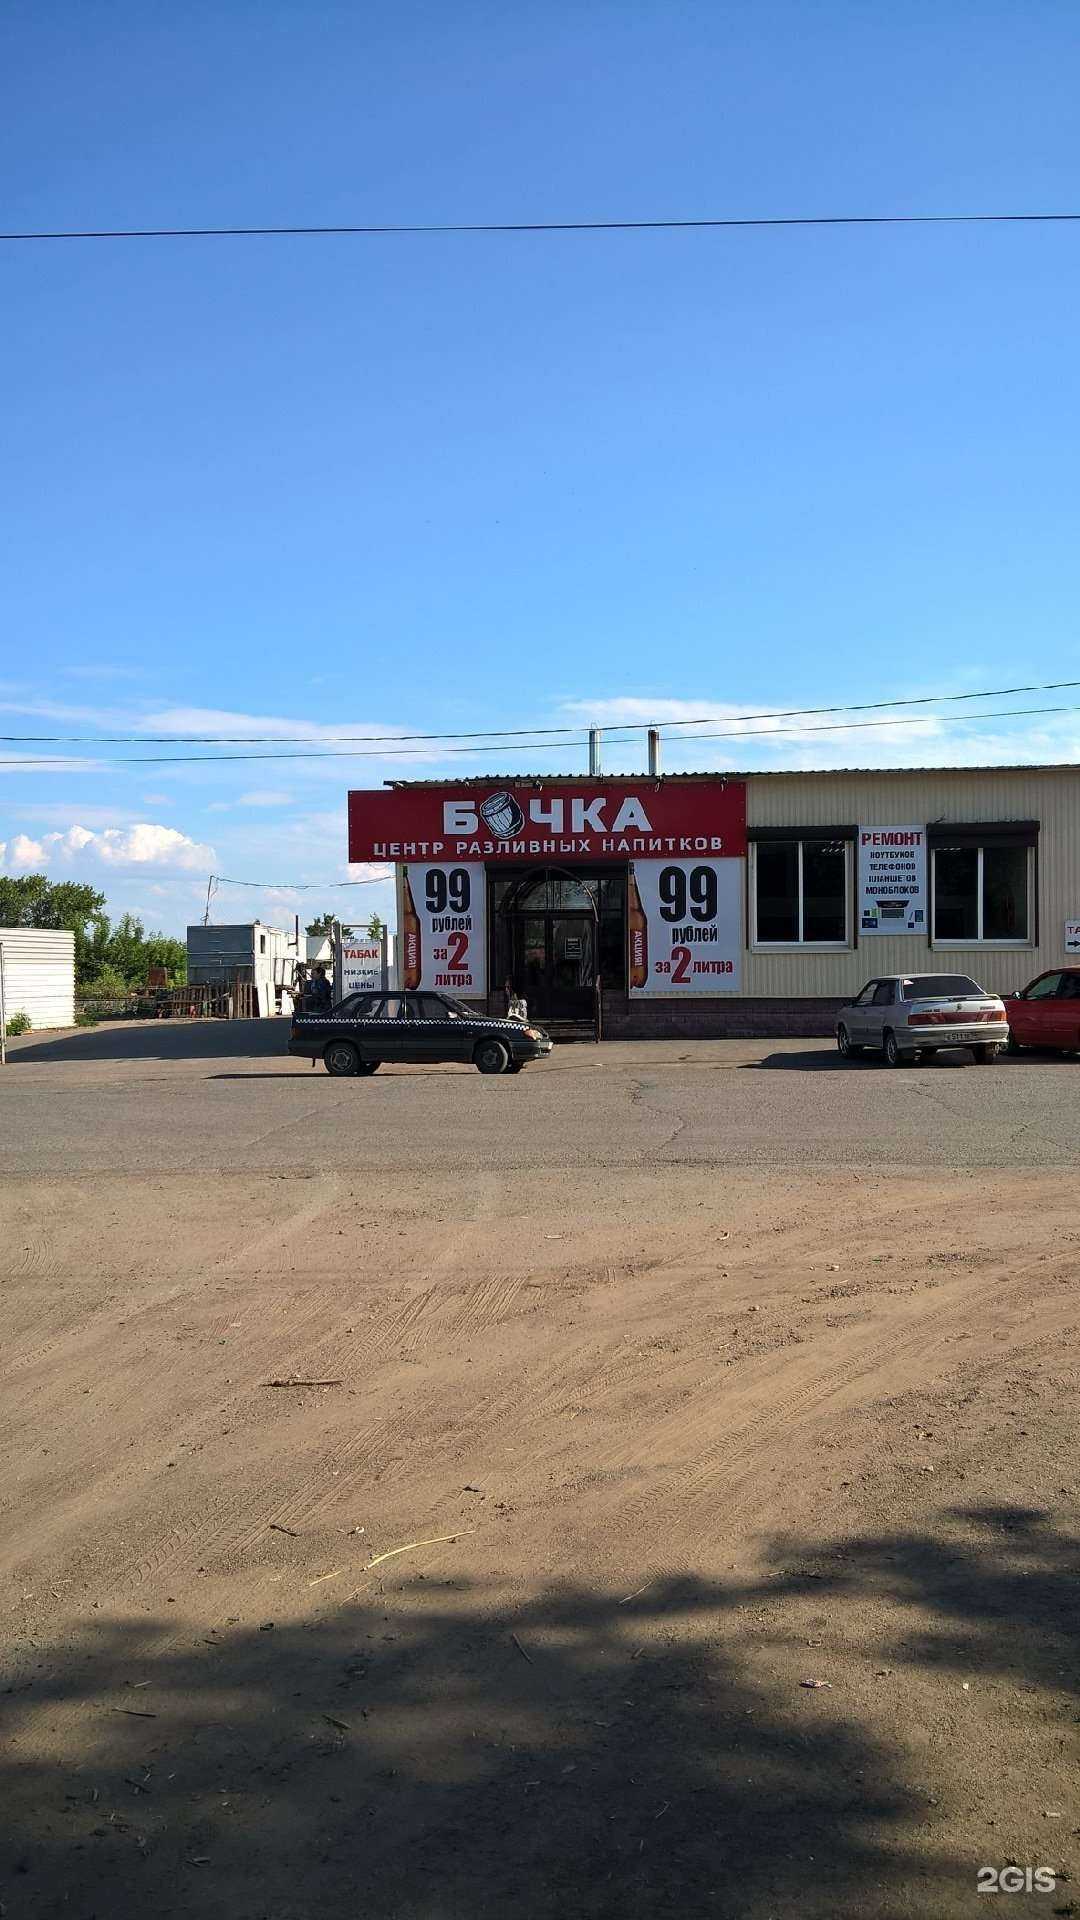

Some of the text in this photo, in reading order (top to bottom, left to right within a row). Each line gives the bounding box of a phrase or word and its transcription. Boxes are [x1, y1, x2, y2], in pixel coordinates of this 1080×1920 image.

[374, 836, 723, 857] ЦЕНТР РАЗЛИВНЫХ НАПИТКОВ
[861, 832, 923, 846] РЕМОНТ
[870, 851, 915, 859] НОУТБУКОВ
[869, 863, 916, 871] ТЕЛЕФОНОВ
[868, 875, 917, 883] ПЛАНШЕТОВ
[425, 868, 471, 913] 99
[659, 866, 718, 922] 99
[865, 886, 920, 895] МОНОБЛОКОВ
[432, 914, 473, 933] рублей
[672, 923, 718, 945] рублей
[343, 949, 379, 959] ТАБАК
[433, 931, 469, 971] за 2
[655, 945, 734, 984] за 2 литра
[434, 973, 473, 987] литра
